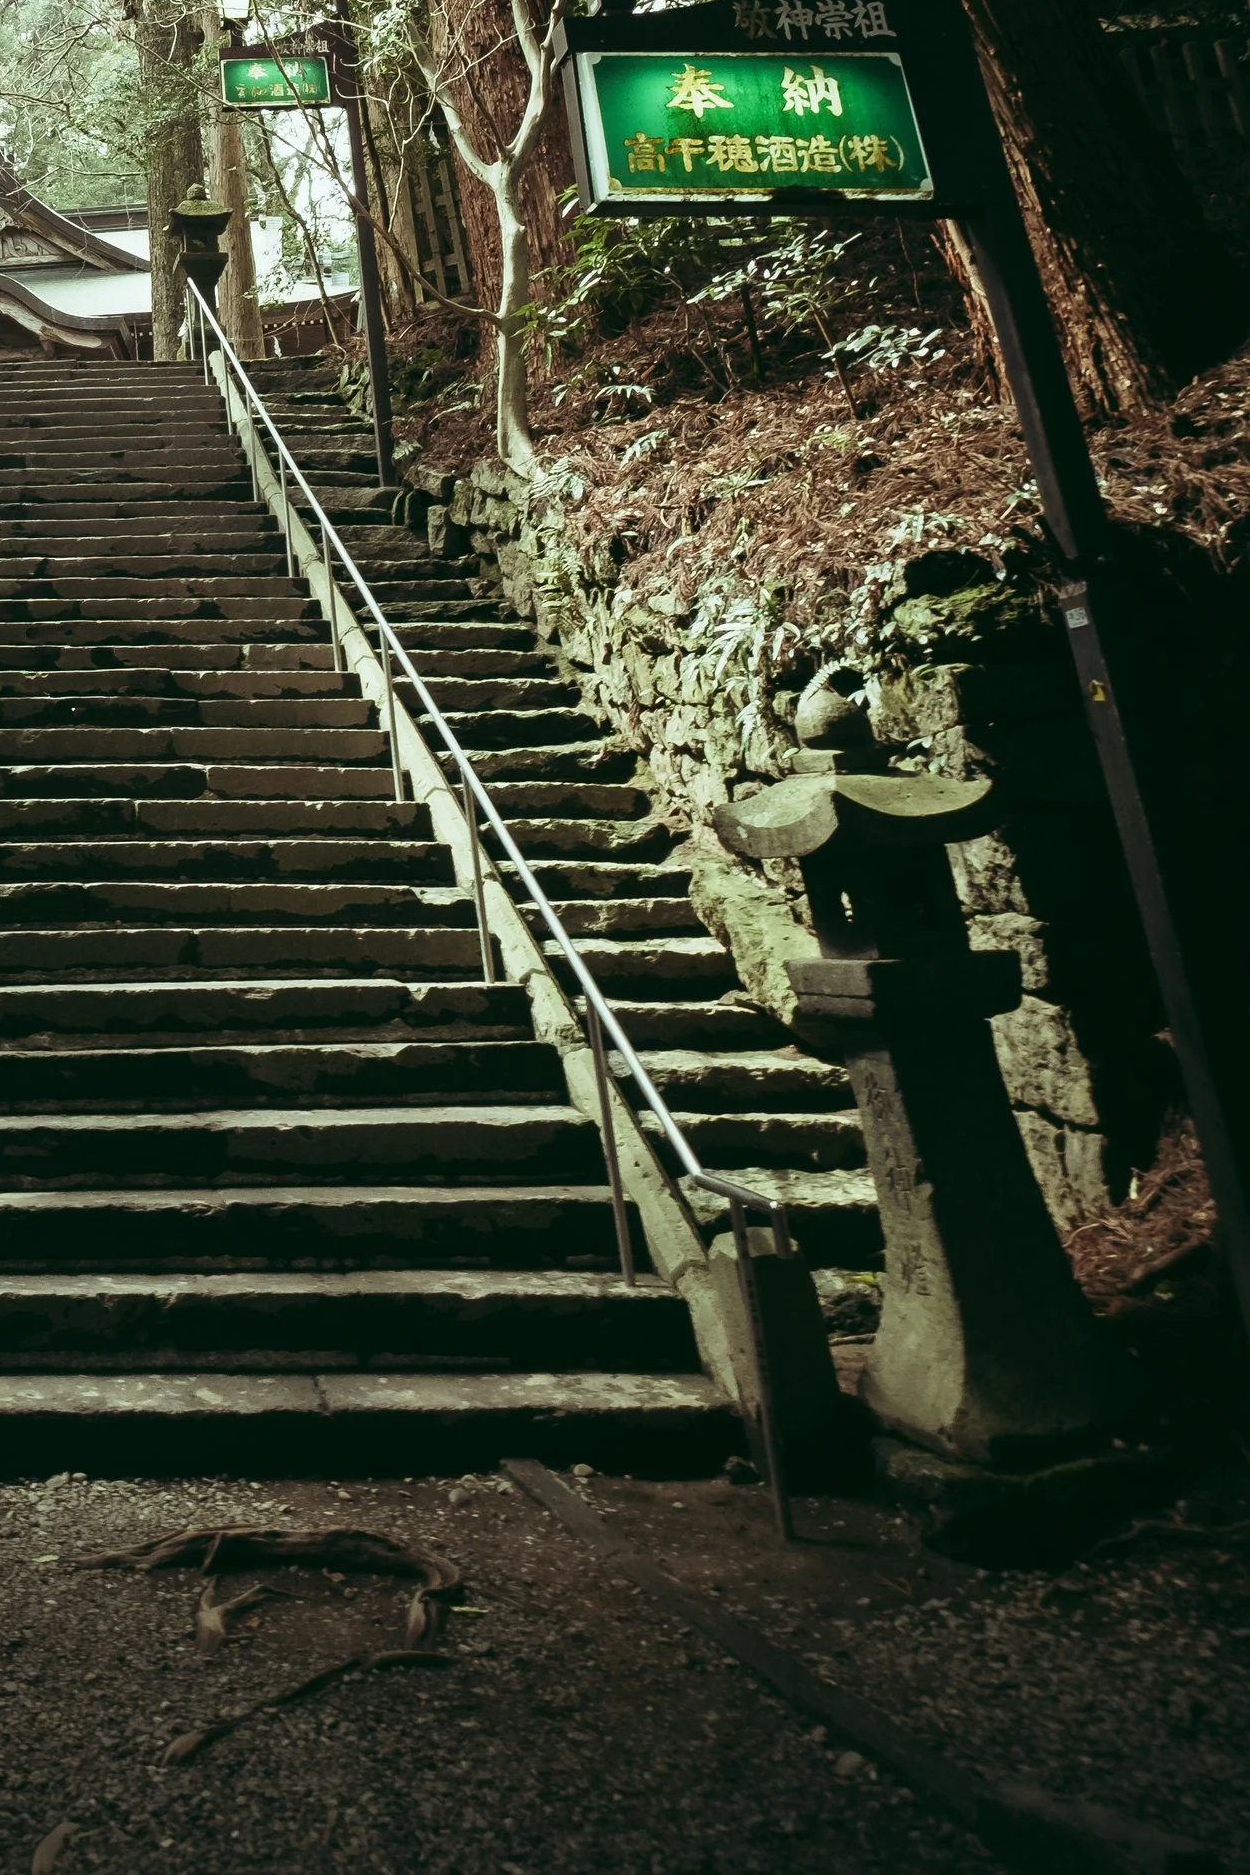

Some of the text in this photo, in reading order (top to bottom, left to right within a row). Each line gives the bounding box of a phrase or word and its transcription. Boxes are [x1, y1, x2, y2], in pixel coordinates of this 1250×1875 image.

[666, 63, 843, 119] 奉納
[623, 131, 905, 174] 高千穂酒造(株)
